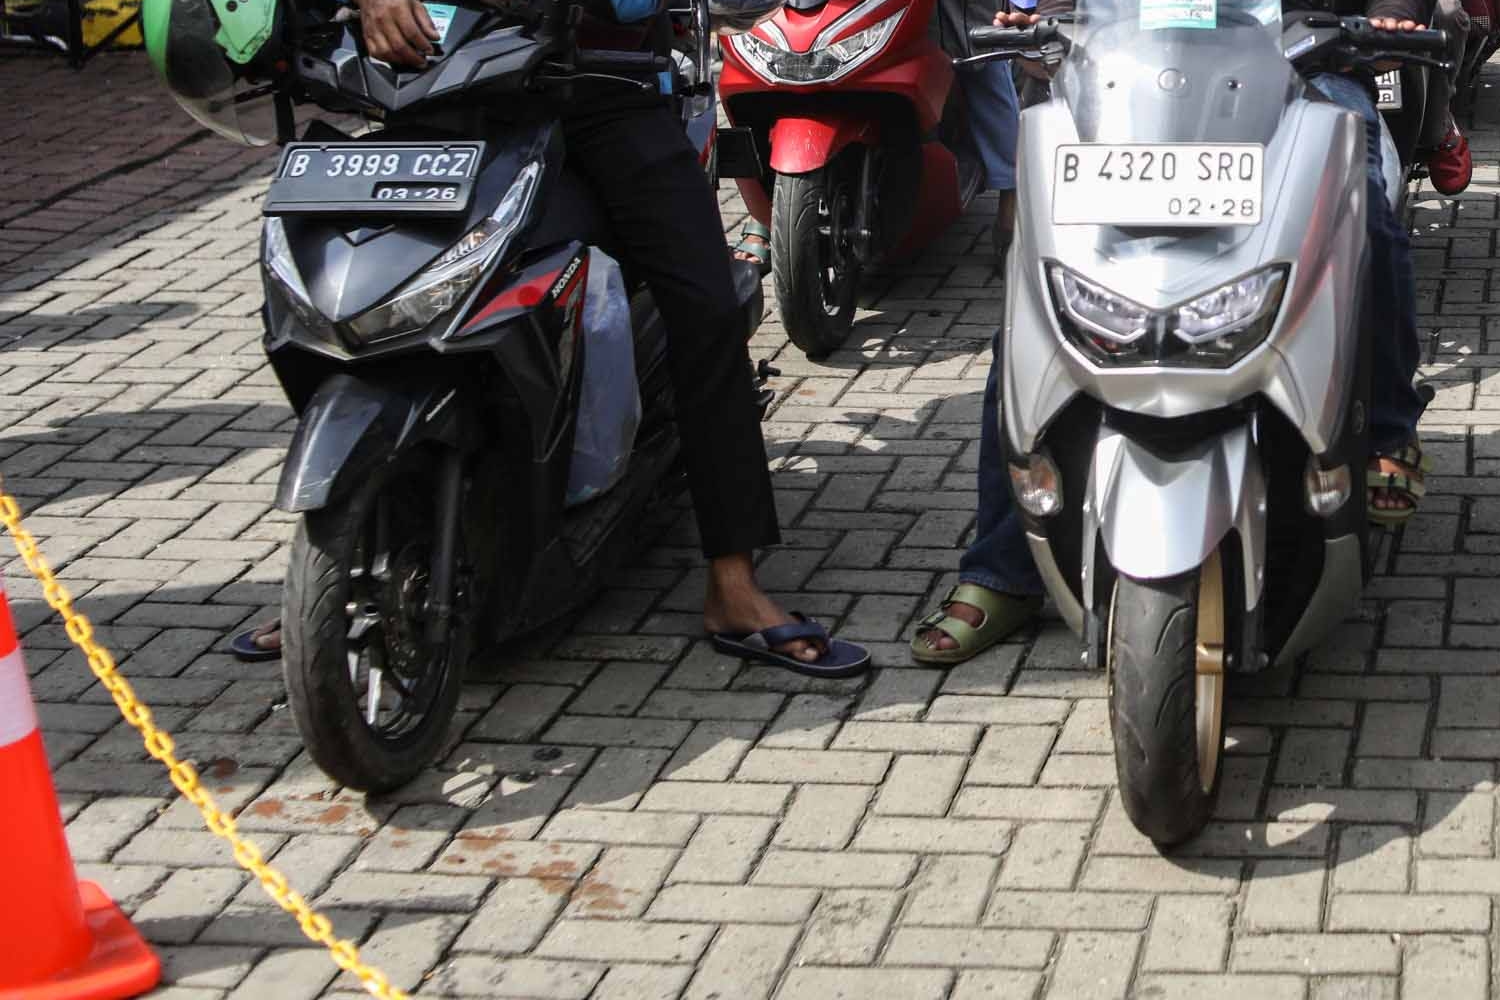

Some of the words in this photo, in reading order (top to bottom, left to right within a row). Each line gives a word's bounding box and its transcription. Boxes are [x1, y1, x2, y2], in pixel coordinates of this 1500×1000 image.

[290, 154, 310, 177] B
[326, 154, 400, 177] 3999
[412, 153, 470, 177] CCZ
[1063, 153, 1080, 182] B
[1098, 151, 1177, 181] 4320
[552, 257, 581, 298] HONDA
